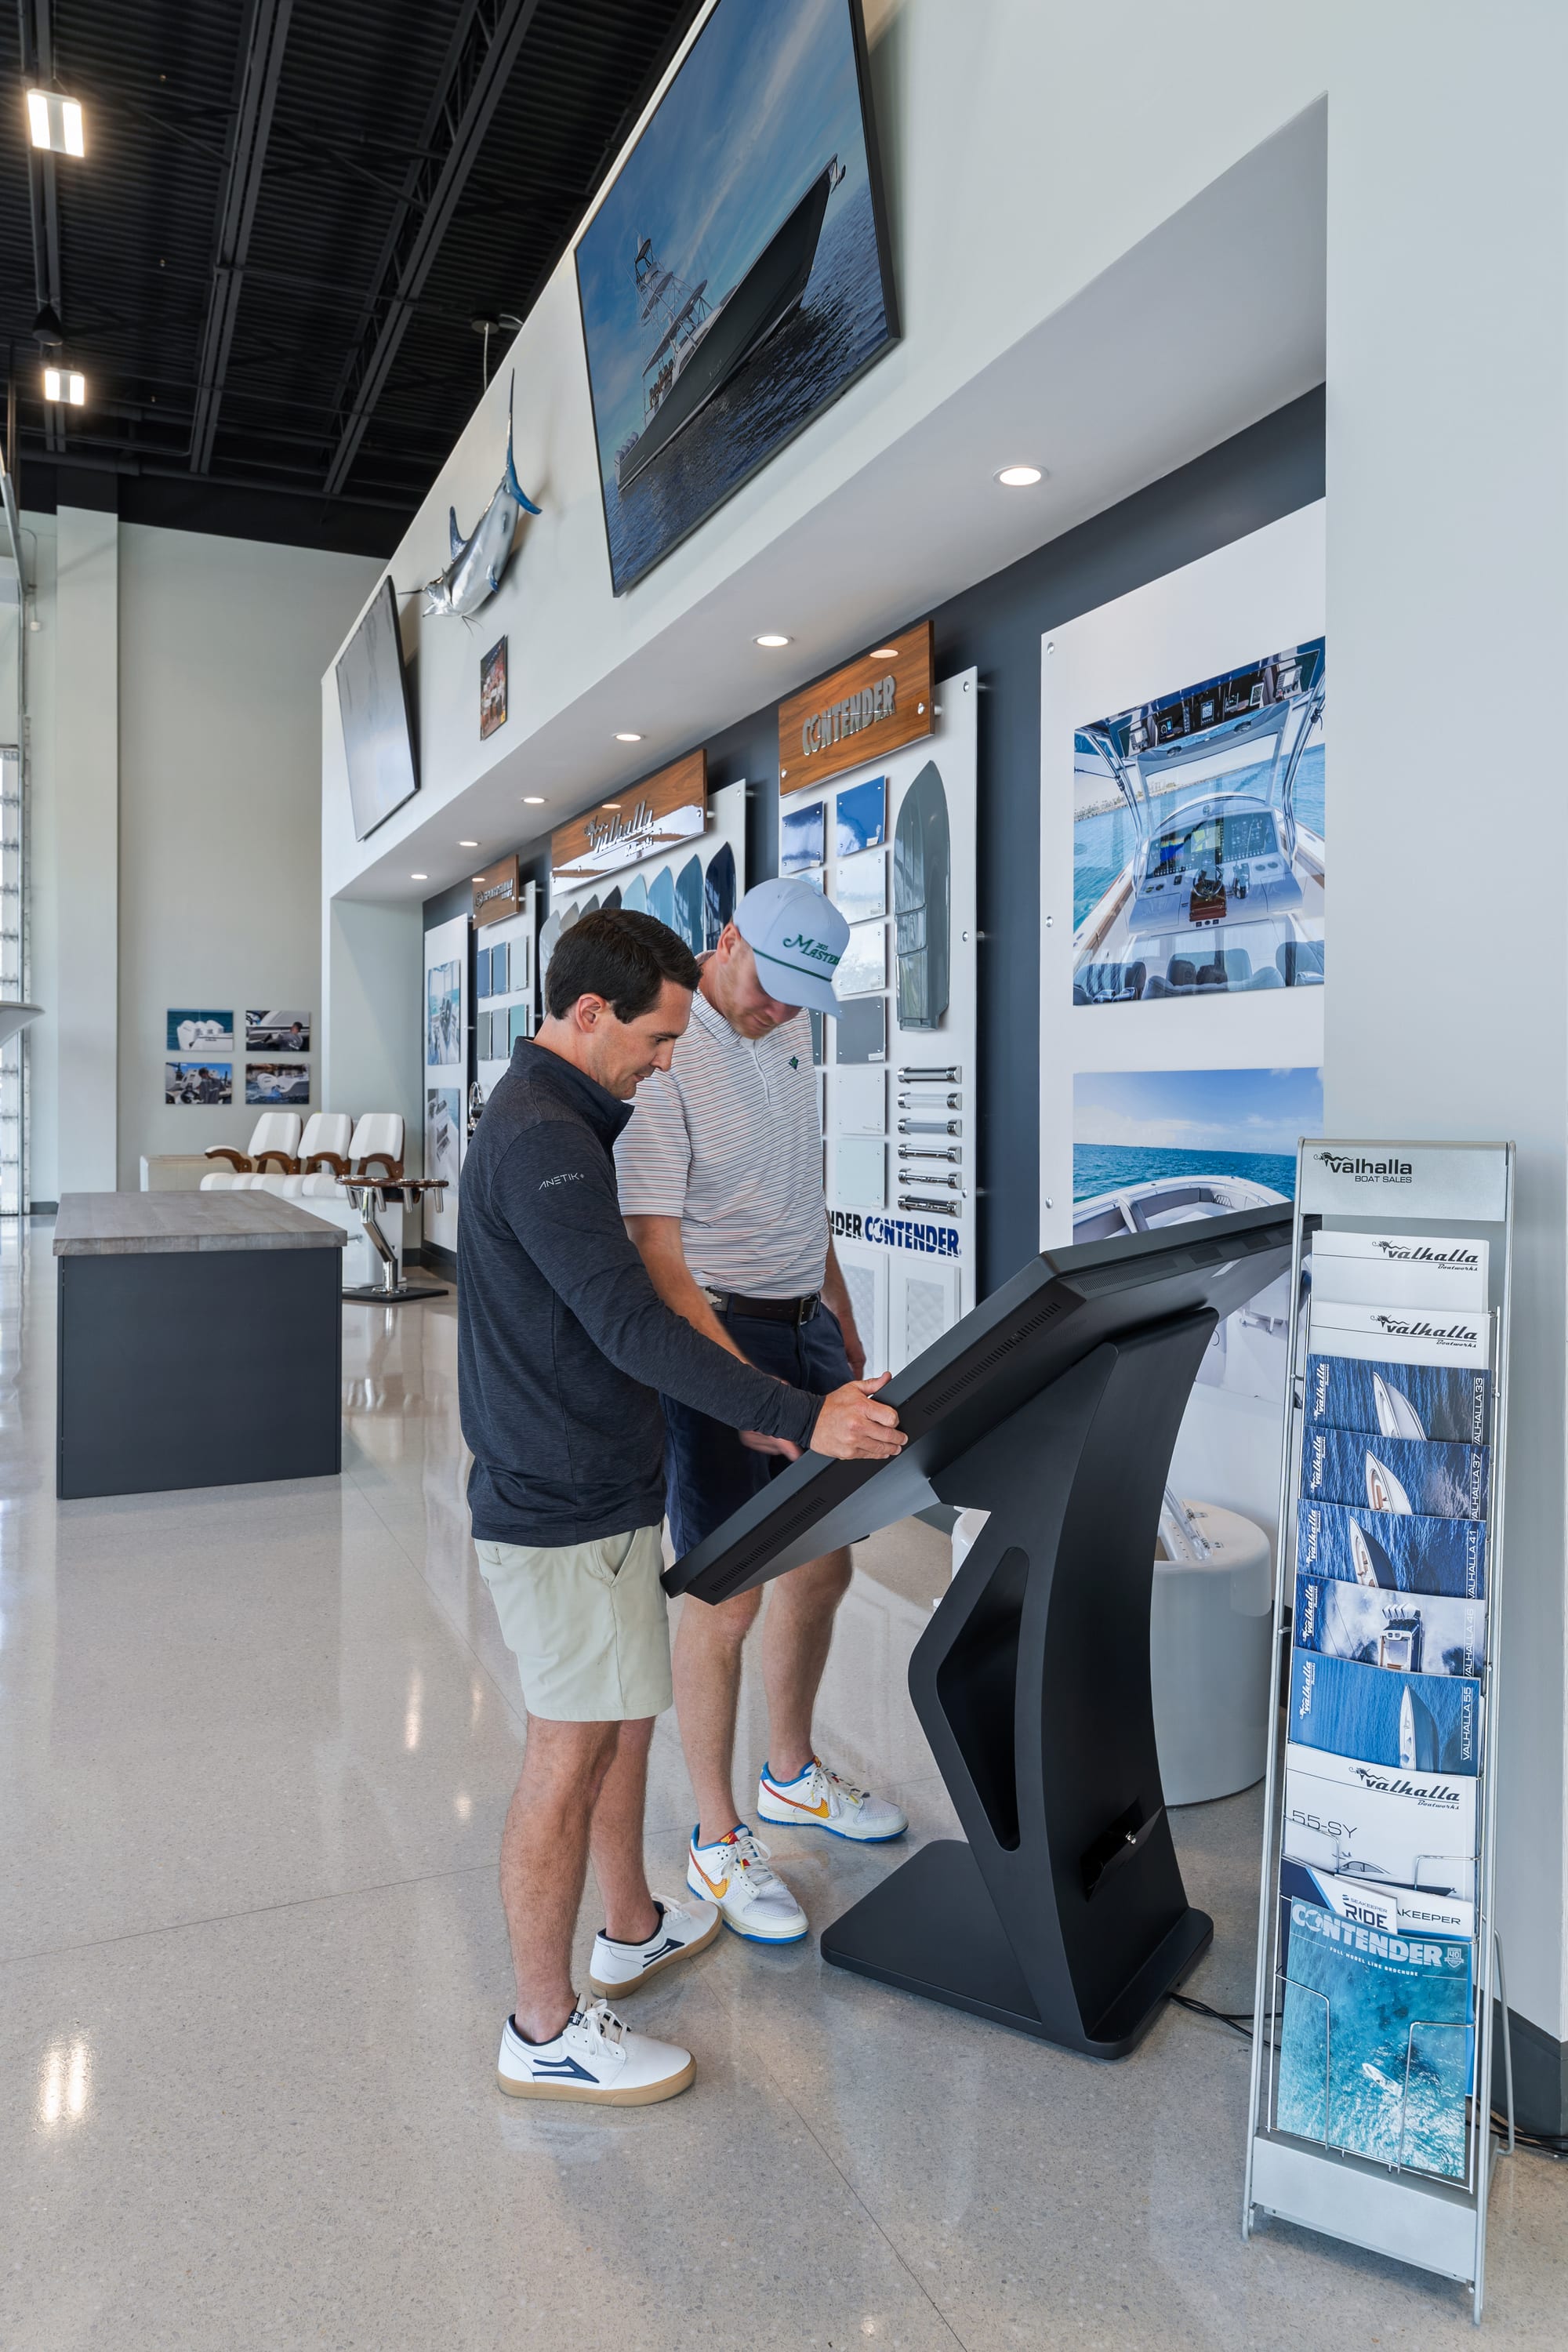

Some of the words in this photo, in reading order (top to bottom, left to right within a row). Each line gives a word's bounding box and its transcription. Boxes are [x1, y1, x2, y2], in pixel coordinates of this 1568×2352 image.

[802, 674, 897, 757] CONTENDER
[1329, 1158, 1413, 1175] valhalla
[539, 1172, 579, 1191] ANETIK
[1382, 1175, 1413, 1184] SALES
[864, 1215, 959, 1258] CONTENDER
[1388, 1247, 1479, 1263] valhalla
[1437, 1263, 1478, 1272] Boatworks
[1386, 1322, 1478, 1341] valhalla
[1436, 1339, 1477, 1348] Boatworks
[1316, 1363, 1325, 1413] valhalla
[1475, 1377, 1483, 1393] 33
[1312, 1435, 1322, 1485] valhalla
[1472, 1453, 1481, 1468] 37
[1308, 1509, 1316, 1559] valhalla
[1468, 1530, 1477, 1544] 41
[1468, 1545, 1476, 1599] VALHALLA
[1304, 1584, 1313, 1634] valhalla
[1466, 1607, 1475, 1624] 46
[1301, 1661, 1311, 1712] valhalla
[1463, 1686, 1472, 1703] 55
[1462, 1704, 1472, 1761] VALHALLA
[1366, 1780, 1461, 1802] valhalla
[1417, 1800, 1460, 1810] Boatworks
[1292, 1809, 1358, 1838] 55-SY
[1350, 1897, 1388, 1913] SEAKEEPER
[1343, 1903, 1388, 1930] RIDE
[1291, 1903, 1443, 1967] CONTENDER
[1330, 1946, 1344, 1956] FULL
[1345, 1952, 1366, 1964] MODEL
[1367, 1959, 1383, 1969] LINE
[1384, 1965, 1419, 1976] BROCHURE
[1449, 1950, 1461, 1959] 40
